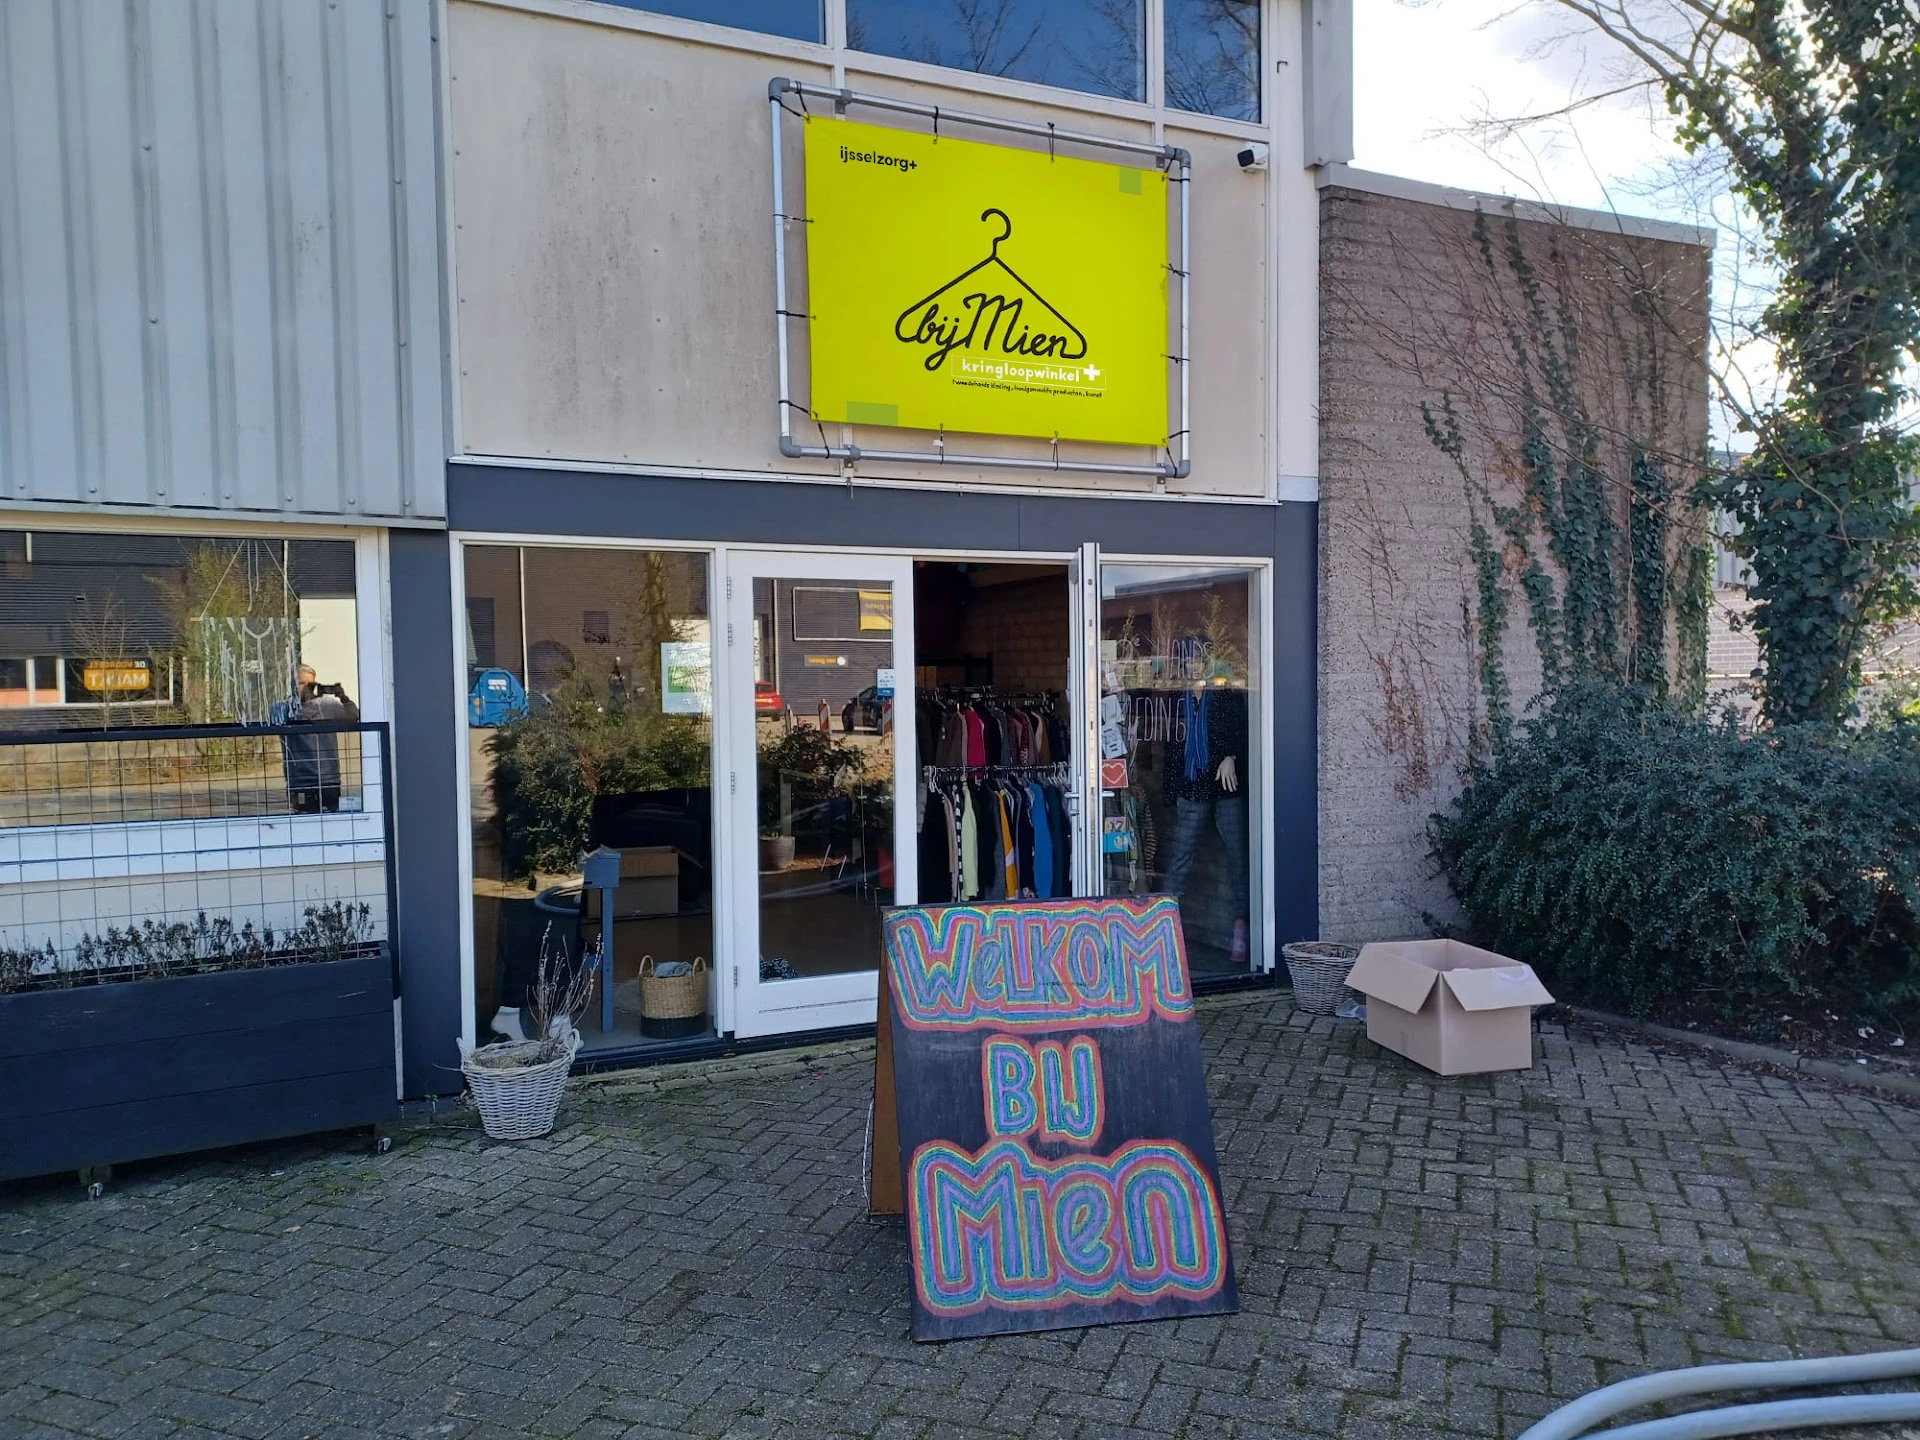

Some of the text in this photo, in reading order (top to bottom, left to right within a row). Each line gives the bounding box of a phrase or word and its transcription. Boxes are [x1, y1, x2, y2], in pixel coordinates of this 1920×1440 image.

[840, 145, 918, 172] ijsselzorg+
[915, 292, 1071, 372] bij Mien
[1126, 696, 1187, 743] LEDING
